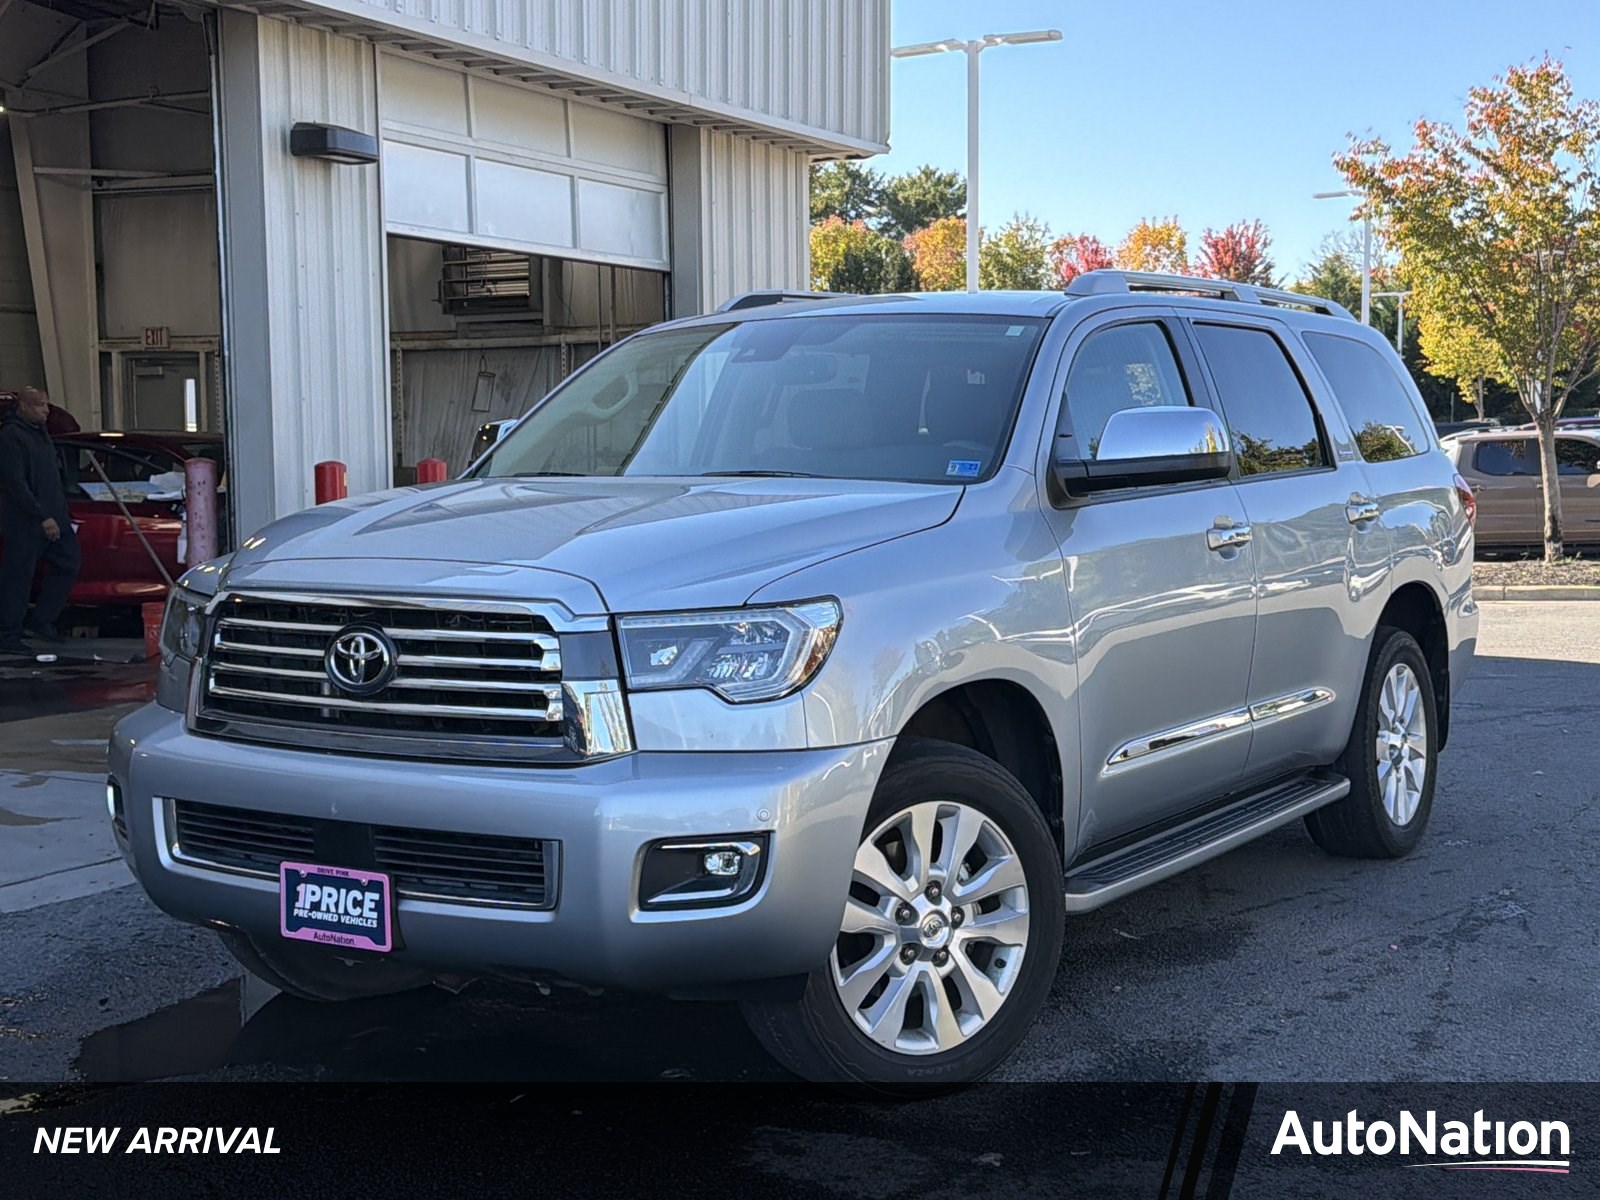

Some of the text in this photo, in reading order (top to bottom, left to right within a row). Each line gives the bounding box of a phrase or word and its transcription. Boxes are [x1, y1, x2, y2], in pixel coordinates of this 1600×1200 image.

[145, 327, 163, 345] EXIT
[295, 883, 380, 919] 1PRICE
[293, 908, 378, 928] PRE-OWNED VEHICLES
[313, 931, 355, 945] AutoNation
